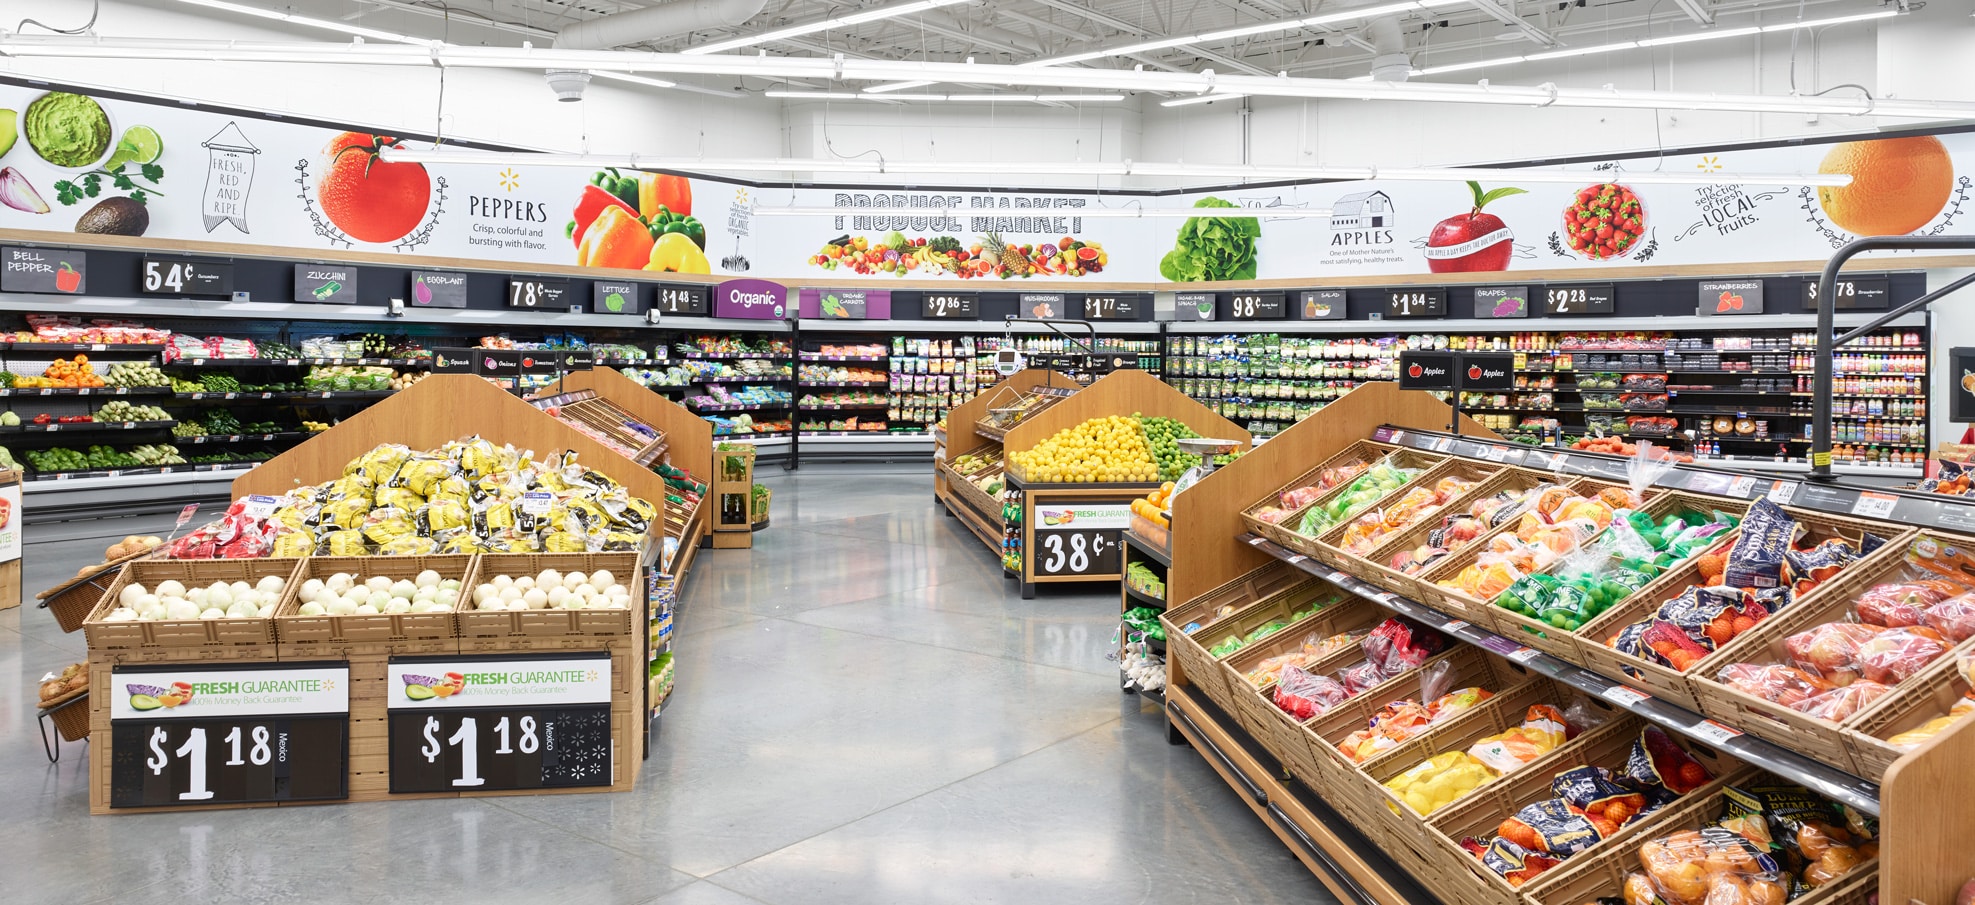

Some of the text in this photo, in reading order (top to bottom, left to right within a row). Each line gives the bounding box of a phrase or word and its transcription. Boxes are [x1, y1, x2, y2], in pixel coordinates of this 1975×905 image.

[219, 173, 239, 186] RED
[217, 188, 240, 201] AND
[1695, 184, 1713, 196] Try
[1703, 190, 1743, 212] of fresh
[469, 195, 548, 223] PEPPERS
[834, 193, 1087, 234] PRODUCE MARKET
[1703, 195, 1758, 227] LOCAL
[472, 223, 543, 238] Crisp, colorful and
[1717, 214, 1760, 236] fruits.
[469, 235, 547, 250] bursting with flavor.
[1331, 229, 1394, 246] APPLES
[13, 250, 46, 262] BELL
[1363, 256, 1385, 264] healthy
[7, 261, 55, 274] PEPPER
[306, 270, 347, 281] ZUCCHINI
[426, 275, 464, 286] EGGPLANT
[602, 285, 631, 294] LETTUCE
[1477, 288, 1507, 297] GRAPES
[730, 289, 776, 308] Organic
[450, 359, 470, 367] Squash
[1423, 367, 1445, 376] Apples
[1483, 369, 1505, 378] Apples
[1073, 510, 1097, 518] FRESH
[463, 670, 585, 686] FRESH GUARANTEE
[191, 679, 322, 695] FRESH GUARANTEE
[484, 687, 510, 696] Money
[511, 685, 530, 695] Back
[530, 686, 568, 694] Guarantee
[213, 696, 242, 707] Money
[243, 695, 262, 704] Back
[263, 695, 303, 704] Guarantee
[545, 722, 554, 752] Mexico
[278, 732, 288, 762] Mexico
